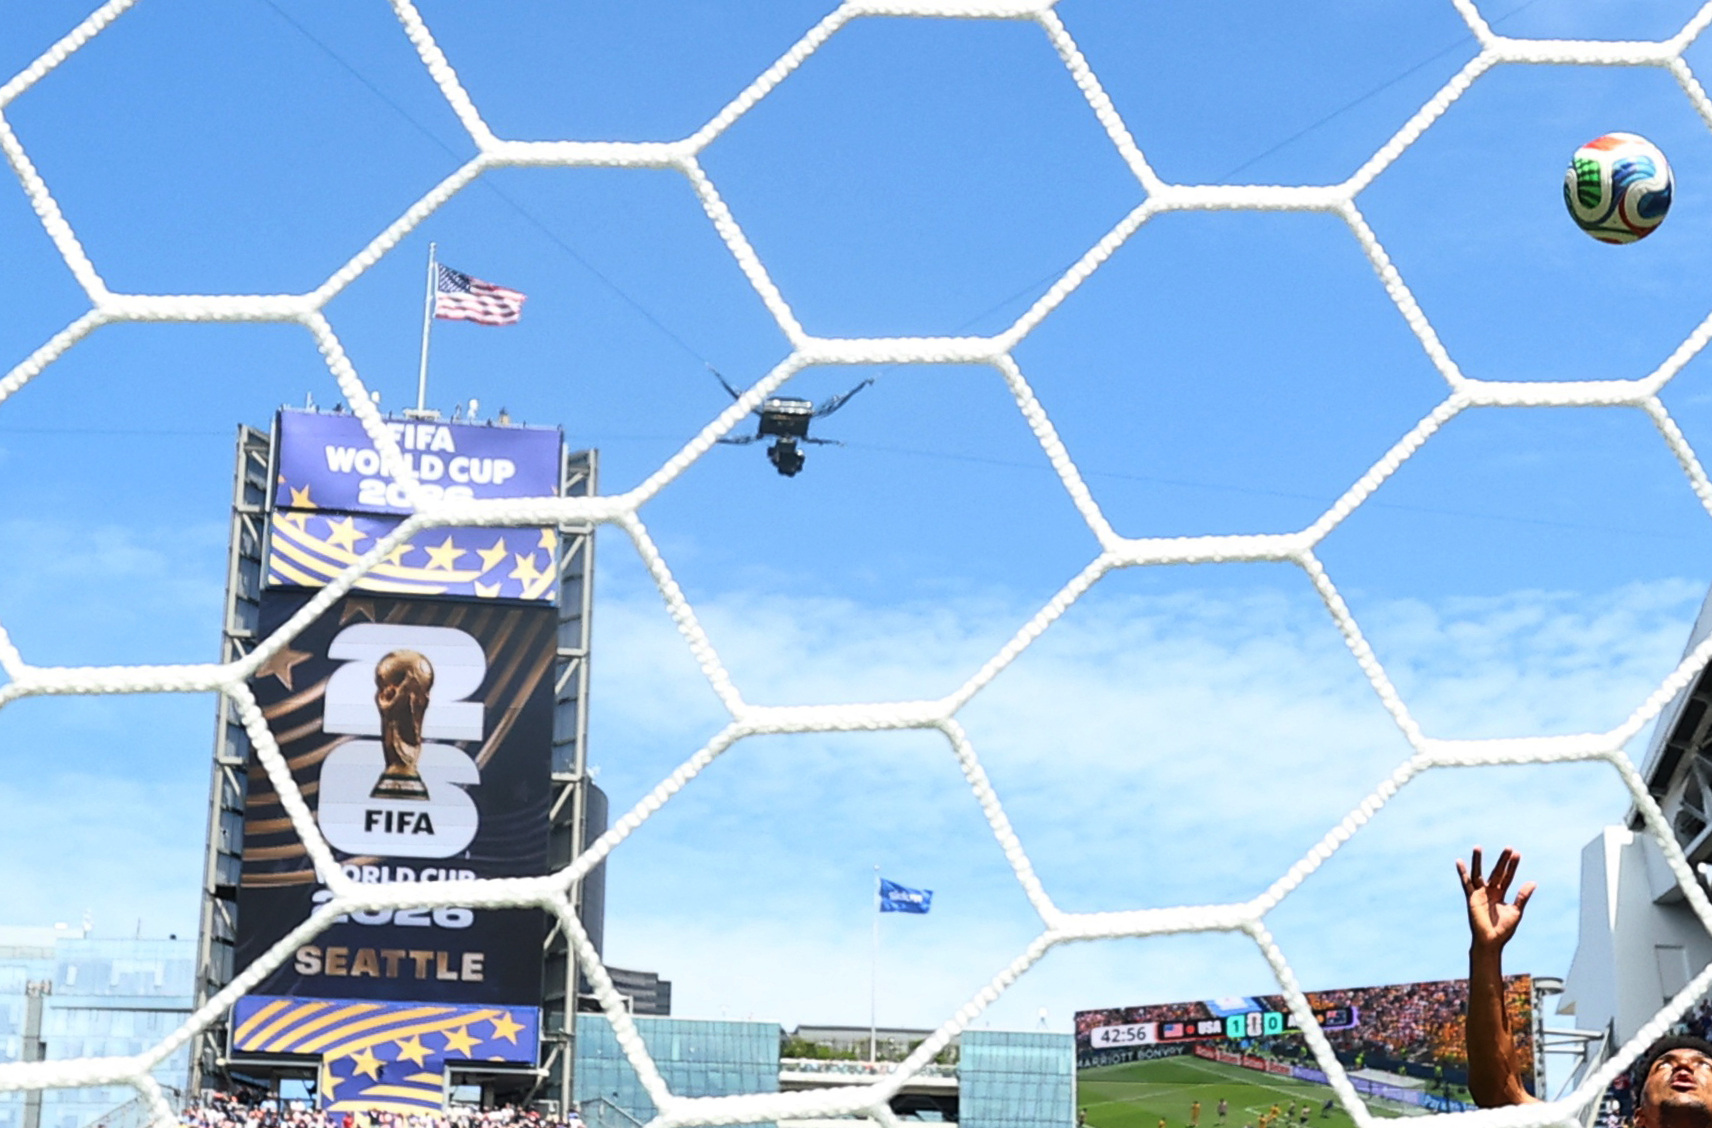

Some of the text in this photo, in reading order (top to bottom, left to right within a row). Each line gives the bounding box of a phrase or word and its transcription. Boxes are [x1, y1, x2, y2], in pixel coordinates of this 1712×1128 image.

[448, 456, 516, 485] CUP
[364, 809, 435, 835] FIFA
[294, 945, 485, 982] SEATTLE
[1197, 1020, 1222, 1035] USA
[1268, 1016, 1278, 1030] 0
[1101, 1026, 1147, 1043] 42:56
